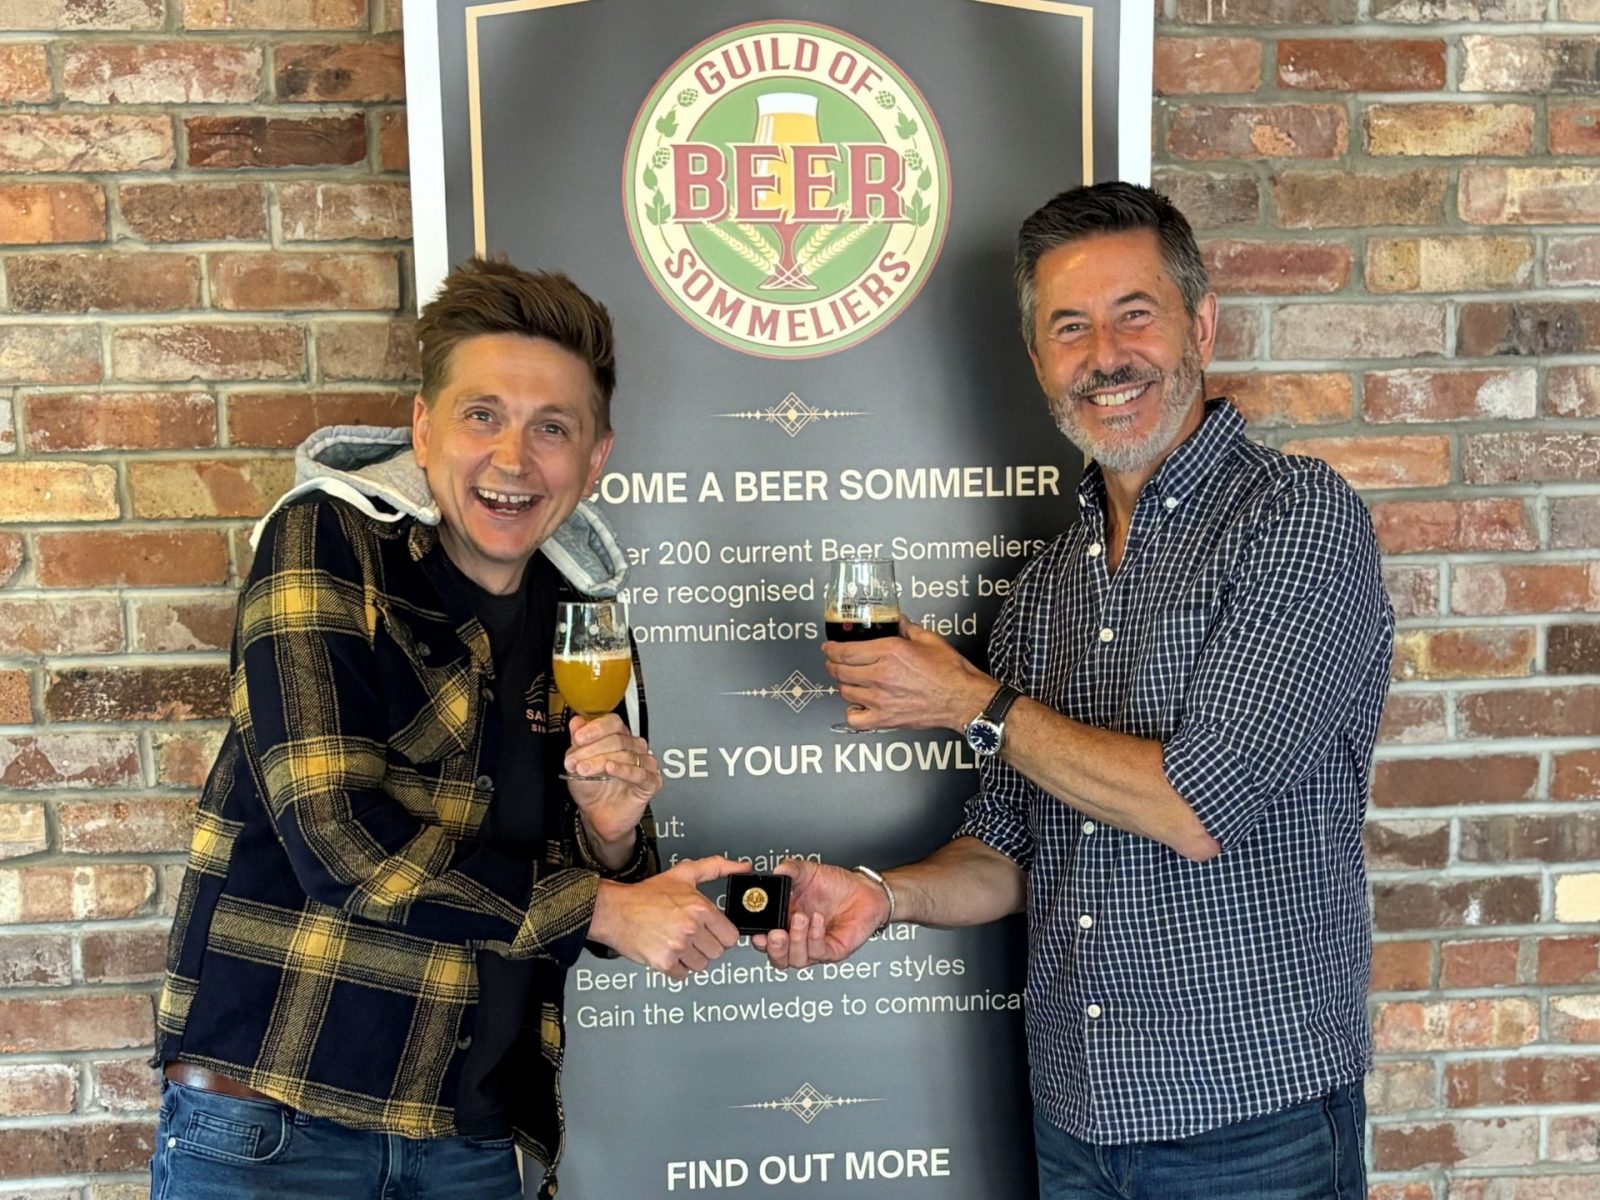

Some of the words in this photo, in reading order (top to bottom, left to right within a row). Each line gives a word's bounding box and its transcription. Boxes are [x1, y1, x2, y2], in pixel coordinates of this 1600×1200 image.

[694, 37, 820, 97] GUILD
[828, 51, 883, 96] OF
[670, 143, 913, 225] BEER
[664, 248, 911, 342] SOMMELIERS
[588, 472, 688, 504] OME
[698, 472, 725, 503] A
[735, 470, 829, 502] BEER
[840, 465, 1060, 501] SOMMELIER
[626, 546, 651, 566] er
[658, 540, 711, 565] 200
[720, 539, 813, 564] current
[822, 538, 884, 561] Beer
[891, 534, 1046, 561] Sommeliers
[667, 577, 815, 609] recognised
[911, 574, 970, 599] best
[978, 574, 1011, 597] be
[632, 617, 819, 644] ommunicators
[920, 612, 977, 636] field
[659, 748, 709, 780] SE
[718, 744, 824, 778] YOUR
[655, 816, 686, 838] ut:
[576, 968, 638, 992] Beer
[823, 960, 882, 981] beer
[889, 954, 966, 982] styles
[577, 1005, 636, 1029] Gain
[643, 1002, 685, 1026] the
[693, 996, 834, 1024] knowledge
[841, 993, 867, 1016] to
[875, 986, 1028, 1014] communicat
[667, 1158, 749, 1191] FIND
[759, 1153, 836, 1185] OUT
[845, 1148, 951, 1181] MORE
